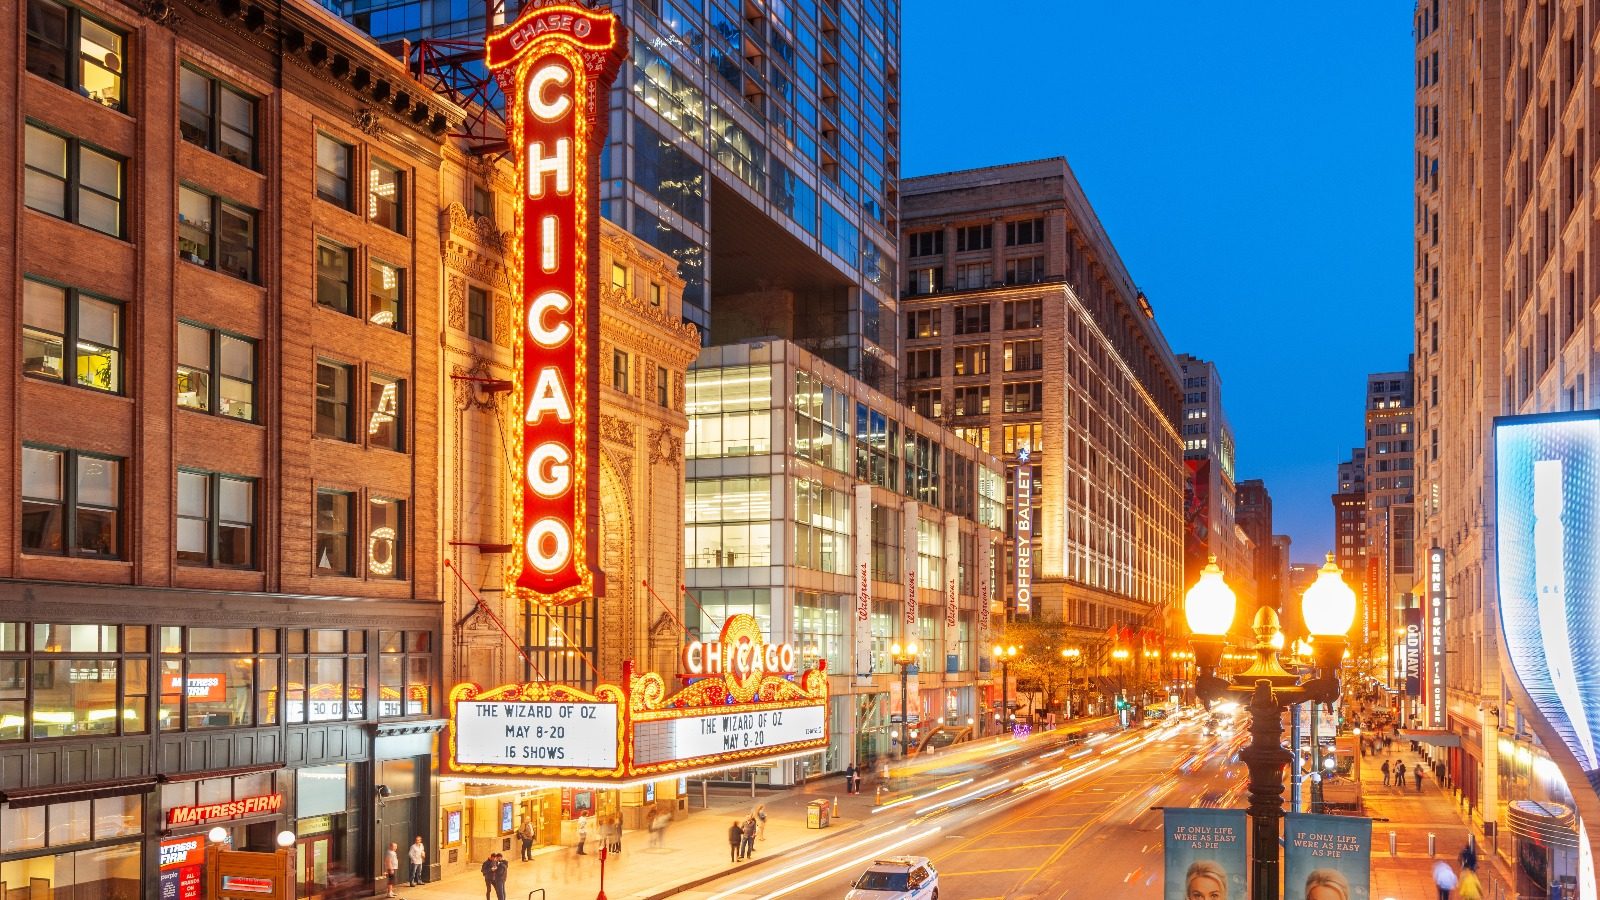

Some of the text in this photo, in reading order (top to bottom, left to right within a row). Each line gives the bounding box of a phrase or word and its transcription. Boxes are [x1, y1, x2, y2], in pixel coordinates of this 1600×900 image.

[509, 15, 574, 51] CHASE
[525, 62, 573, 574] CHICAGO
[1017, 468, 1030, 612] JOFFREY BALLET
[858, 562, 871, 622] Walgreens
[906, 570, 919, 625] Walgreens
[947, 578, 959, 628] Walgreens
[1431, 553, 1441, 723] GENE SISKEL FILM CENTER
[687, 640, 795, 674] CHICAGO
[1407, 624, 1419, 679] OLD NAVY
[172, 677, 219, 688] MTTRESS
[475, 704, 597, 720] THE WIZARD OF OZ
[700, 711, 783, 735] THE WIZARD OF OZ
[505, 725, 565, 739] MAY 8-20
[723, 732, 765, 751] MAY 8-20
[505, 746, 565, 760] 16 SHOWS
[1173, 833, 1197, 841] WERE
[1214, 834, 1237, 842] EASY
[1188, 826, 1212, 834] ONLY
[1214, 827, 1233, 835] LIFE
[1297, 832, 1357, 844] IF ONLY LIFE
[1191, 841, 1202, 849] AS
[1293, 839, 1360, 852] WERE AS EASY
[161, 851, 188, 864] FIRM
[1311, 849, 1342, 859] AS PIE
[161, 872, 178, 881] purple
